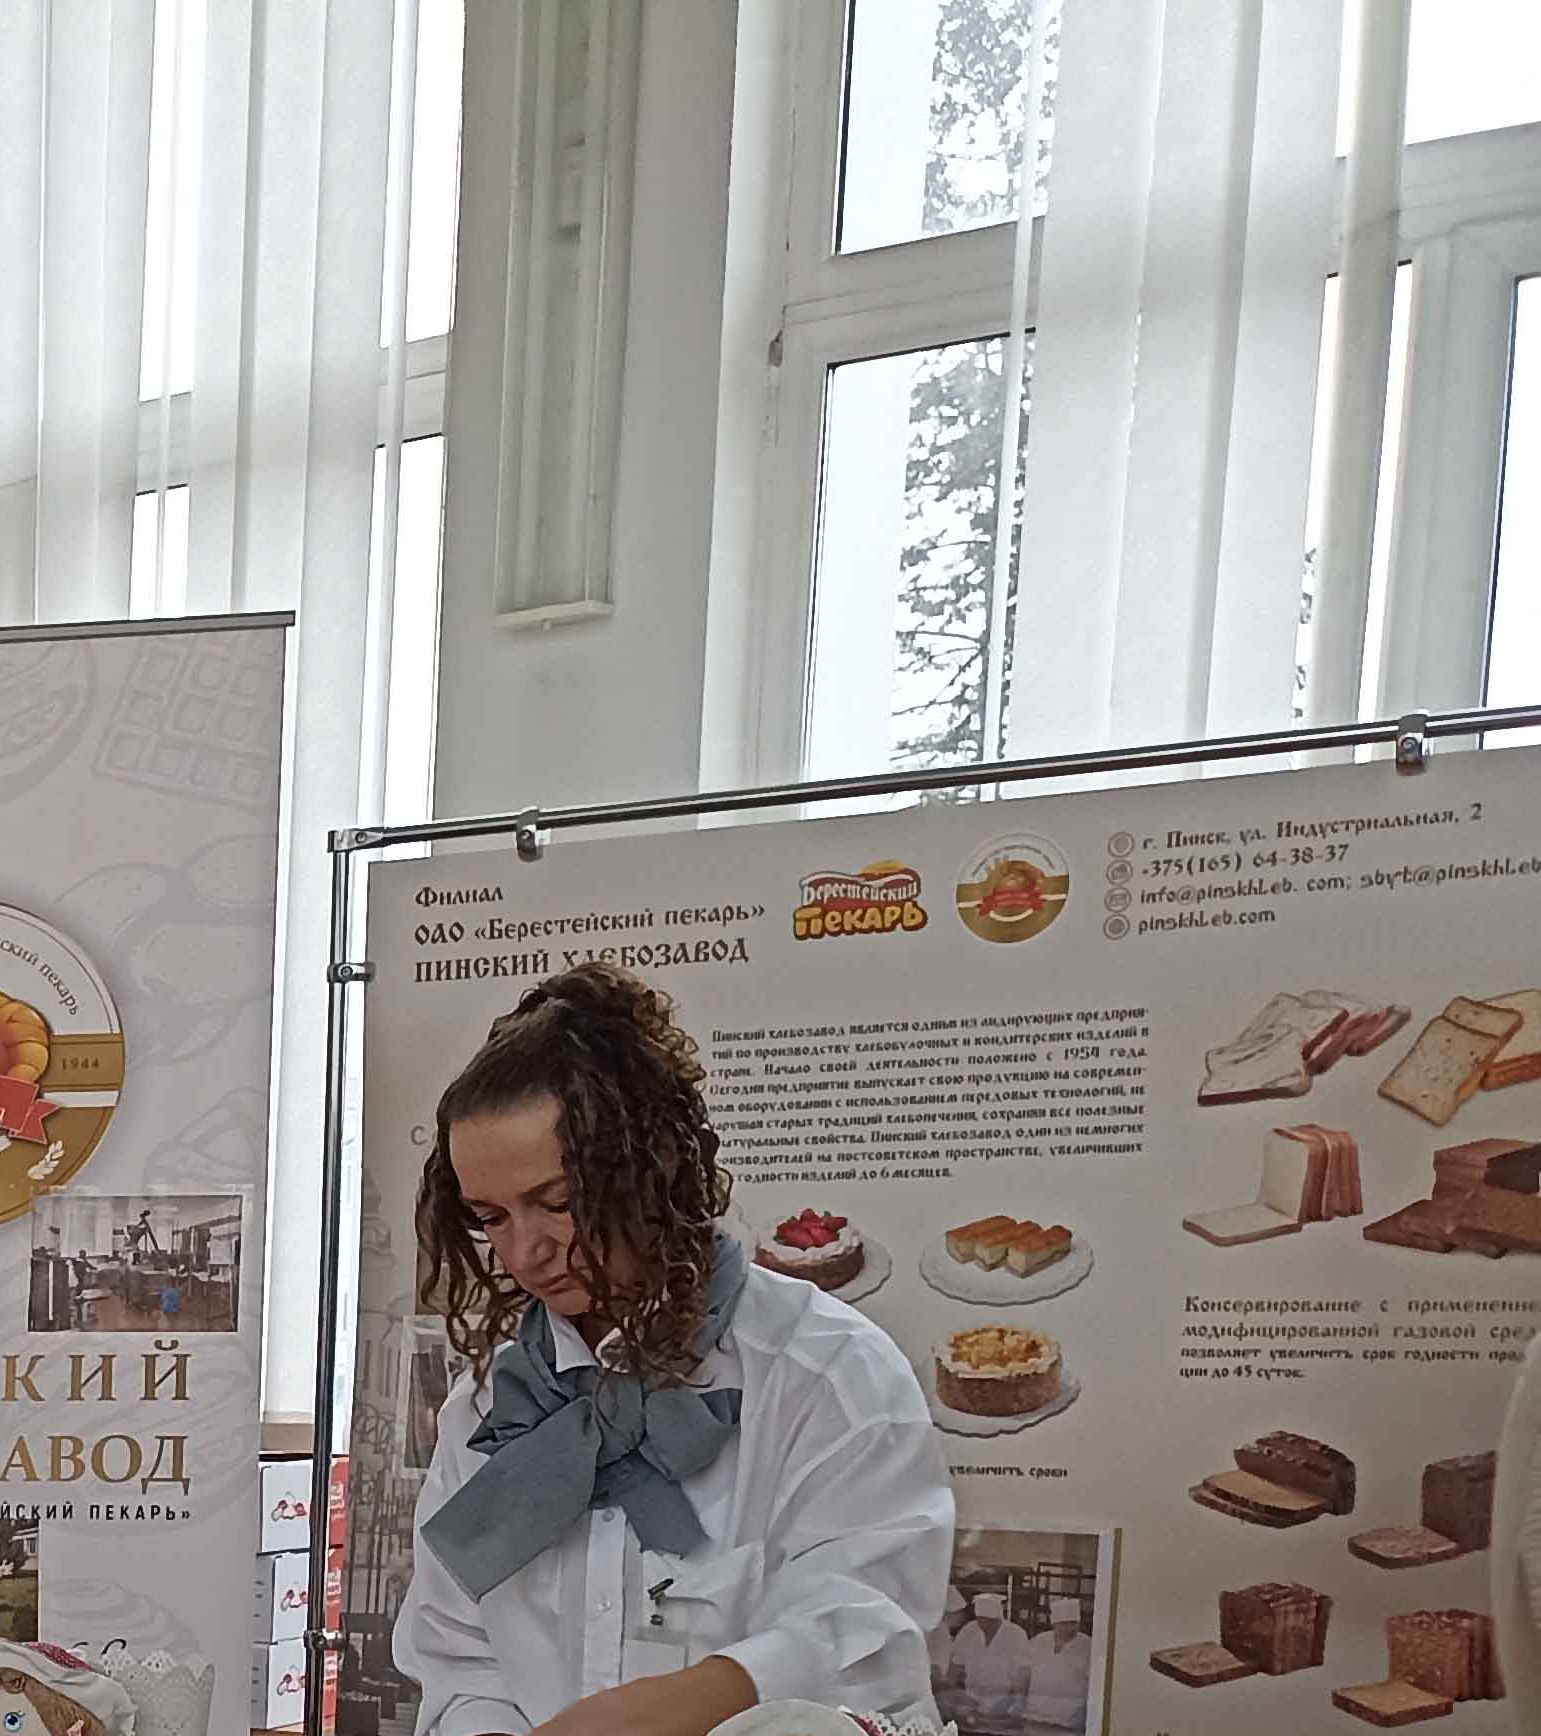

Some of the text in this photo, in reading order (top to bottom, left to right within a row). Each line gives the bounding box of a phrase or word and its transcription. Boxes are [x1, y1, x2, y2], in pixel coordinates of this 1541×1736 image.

[1239, 829, 1266, 845] ул.
[1470, 803, 1482, 820] 2
[1253, 844, 1349, 868] 64-38-37
[415, 886, 503, 907] Филиал
[415, 904, 765, 945] ОАО «Берестейский пекарь»
[415, 949, 549, 982] ПИНСКИЙ
[39, 962, 79, 1016] пекарь
[769, 1026, 845, 1039] хлебозавод
[849, 1022, 909, 1034] является
[961, 1018, 977, 1028] из
[981, 1011, 1072, 1027] лидирующих
[736, 1047, 751, 1058] по
[755, 1044, 850, 1060] производству
[855, 1037, 958, 1053] хлебобулочных
[962, 1037, 970, 1047] и
[974, 1032, 1072, 1046] кондитерских
[1077, 1027, 1137, 1041] изделий
[1141, 1028, 1149, 1037] в
[765, 1063, 810, 1076] Начало
[819, 1060, 857, 1072] своей
[866, 1057, 959, 1071] деятельности
[968, 1053, 1037, 1065] положено
[1046, 1052, 1052, 1062] с
[768, 1079, 849, 1094] предприятие
[854, 1076, 924, 1090] выпускает
[929, 1074, 964, 1085] свою
[968, 1070, 1049, 1086] продукцию
[1054, 1070, 1069, 1080] на
[738, 1100, 832, 1114] оборудовании
[835, 1099, 841, 1108] с
[846, 1092, 957, 1108] использованием
[962, 1090, 1037, 1104] передовых
[1130, 1085, 1145, 1095] не
[767, 1119, 812, 1130] старых
[818, 1113, 882, 1128] традиций
[982, 1108, 1046, 1122] сохраняя
[1050, 1108, 1070, 1117] все
[1076, 1105, 1145, 1117] полезные
[721, 1137, 799, 1150] атуральные
[870, 1130, 926, 1142] Пинский
[931, 1128, 1011, 1141] хлебозавод
[1016, 1127, 1051, 1138] один
[1055, 1127, 1072, 1137] из
[1075, 1124, 1144, 1135] немногих
[717, 1153, 812, 1165] оизводителей
[817, 1153, 832, 1163] на
[837, 1150, 939, 1162] постсоветском
[801, 1169, 856, 1182] изделий
[858, 1169, 877, 1181] до
[880, 1167, 889, 1178] 6
[1185, 1296, 1388, 1316] Консервирование с
[1182, 1322, 1475, 1341] модифицированной газовой
[1181, 1348, 1479, 1363] позволяет увеличить срок годности
[1211, 1367, 1228, 1379] до
[1233, 1365, 1252, 1377] 45
[89, 1502, 193, 1521] ПЕКАРЬ»
